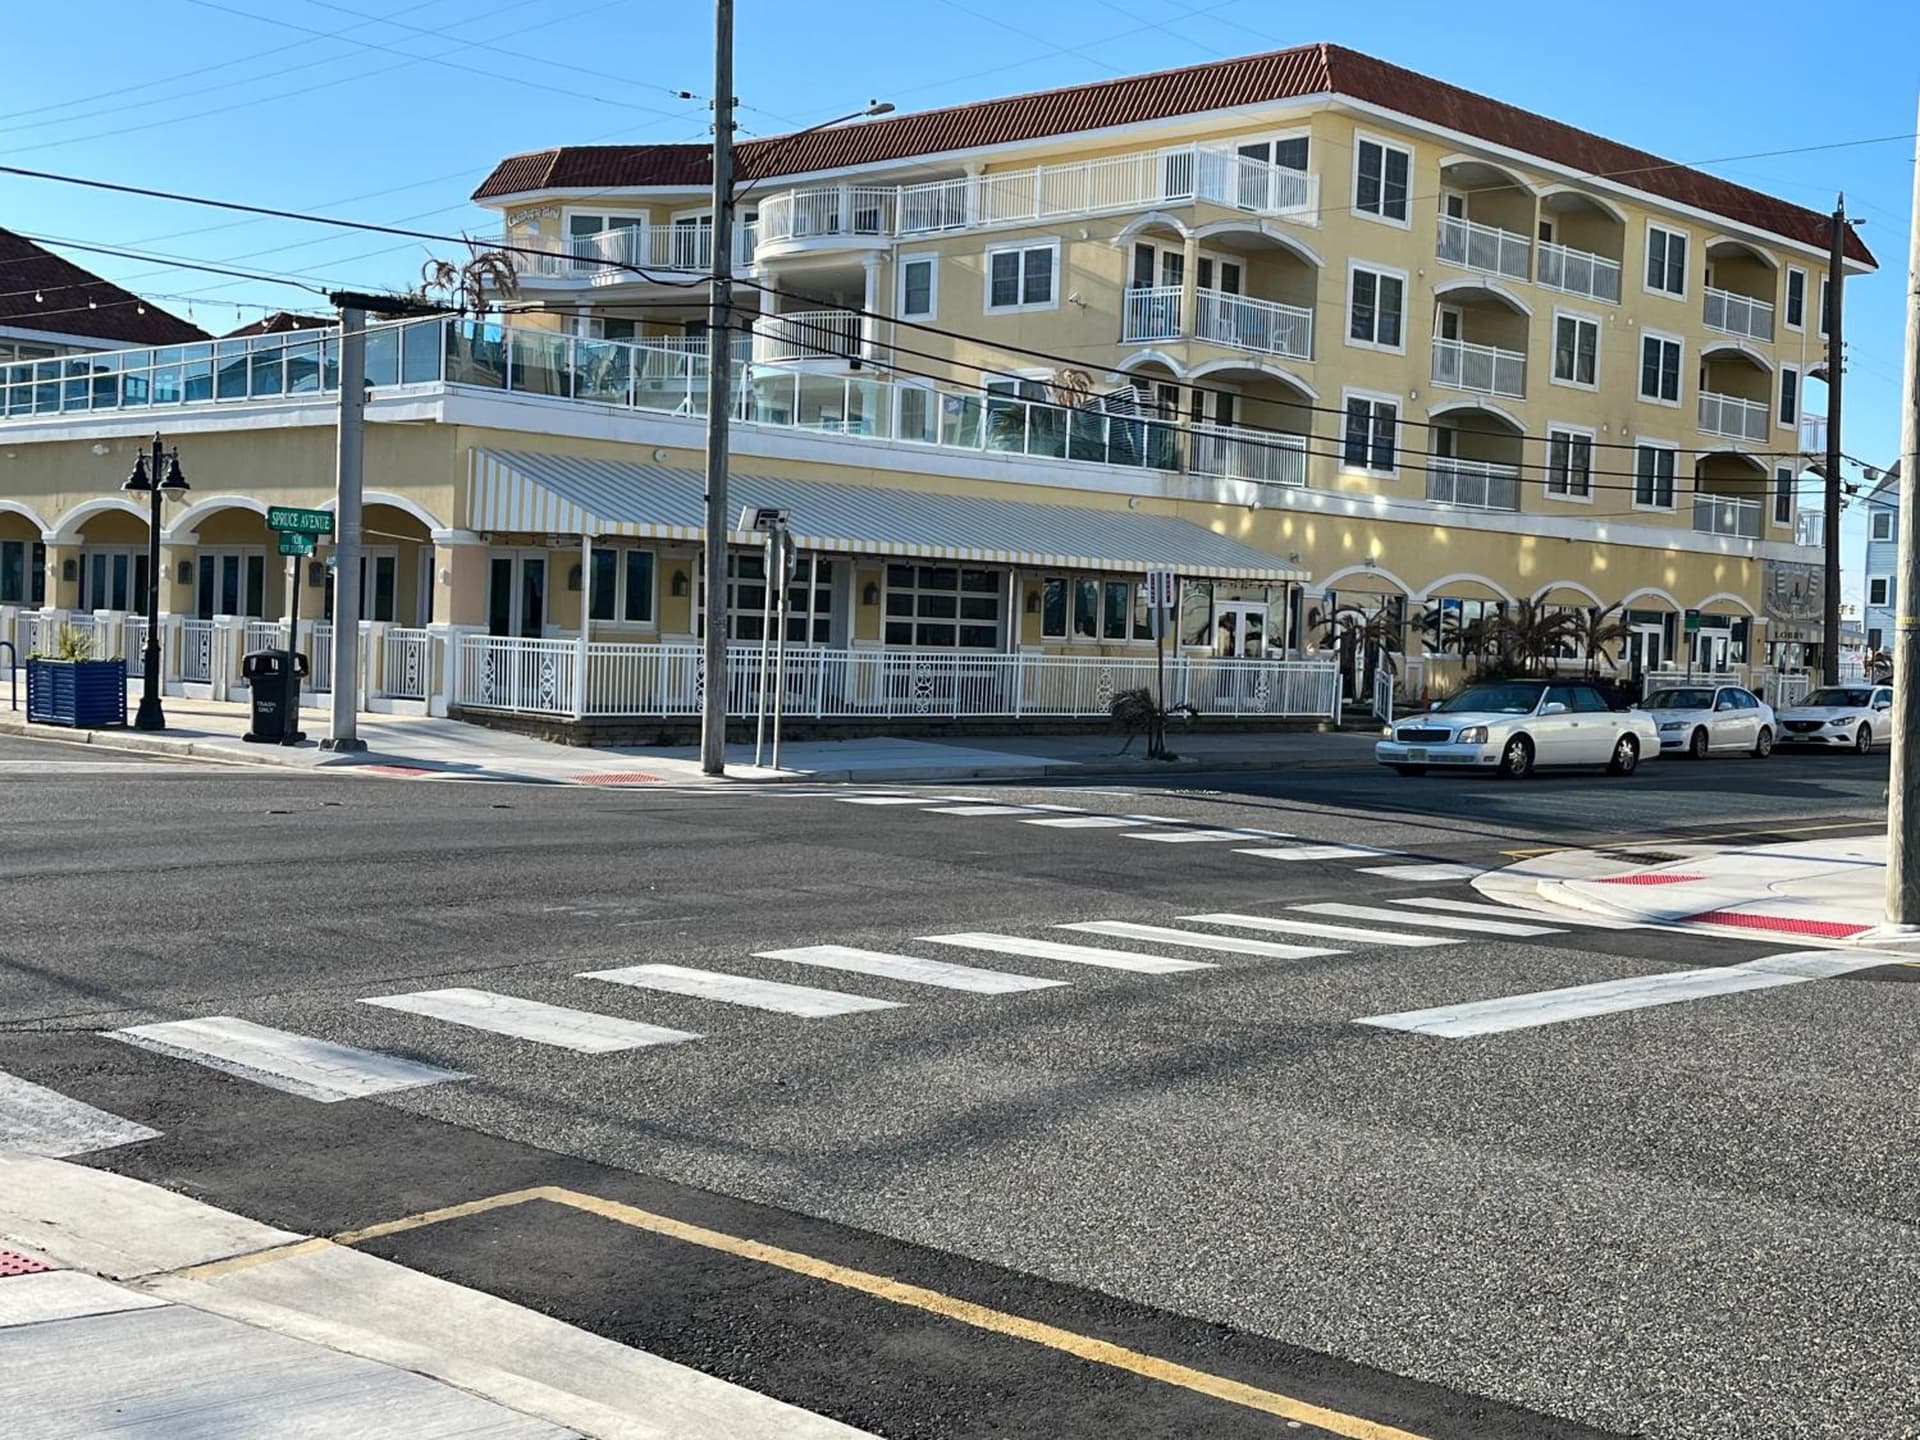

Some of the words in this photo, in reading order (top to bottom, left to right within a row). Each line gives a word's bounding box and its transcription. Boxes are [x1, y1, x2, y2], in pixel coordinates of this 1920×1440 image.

[271, 511, 299, 527] SPRUCE
[300, 513, 330, 530] AVENUE
[1774, 631, 1804, 639] LOBBY
